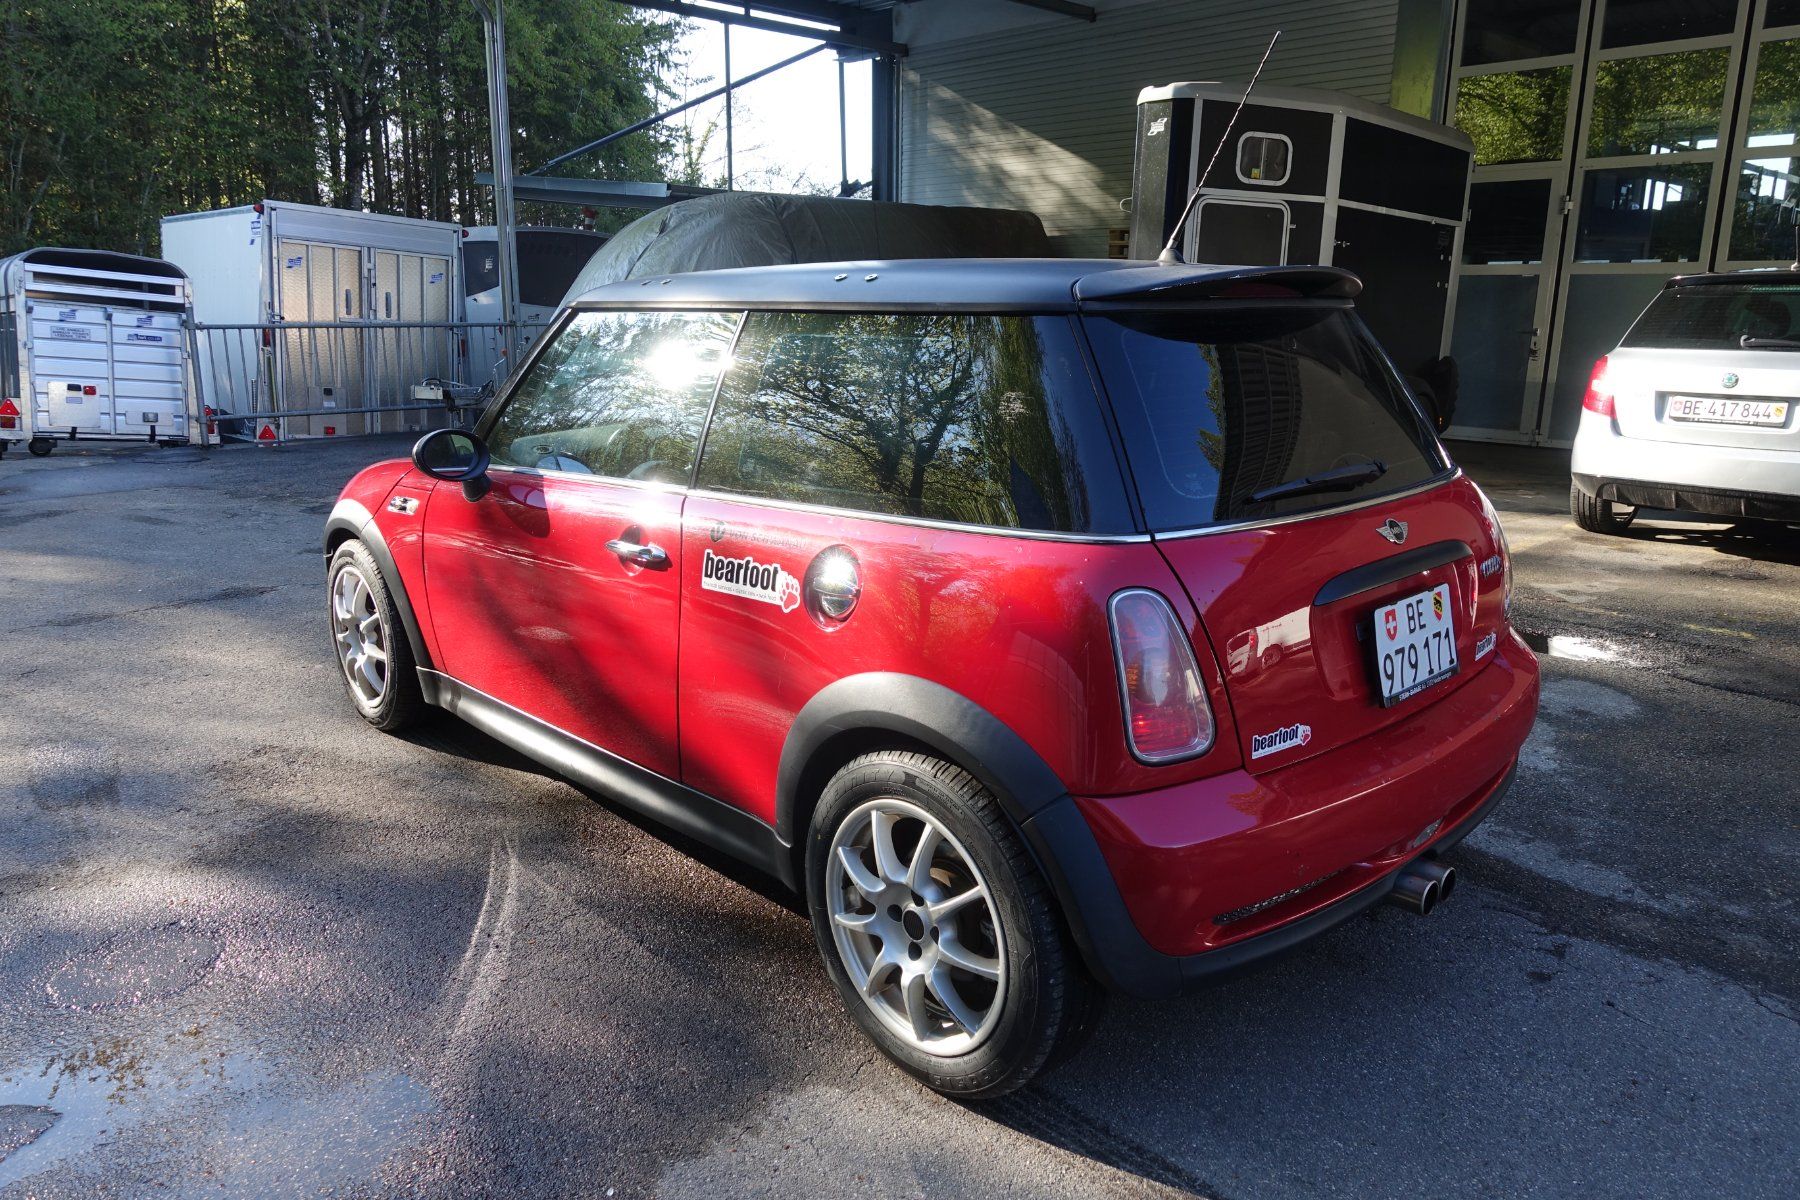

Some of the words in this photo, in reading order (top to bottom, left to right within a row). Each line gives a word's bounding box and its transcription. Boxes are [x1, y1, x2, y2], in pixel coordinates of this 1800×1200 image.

[704, 551, 779, 592] bearfoot
[1406, 599, 1426, 635] BE
[1253, 725, 1299, 753] bearfoot
